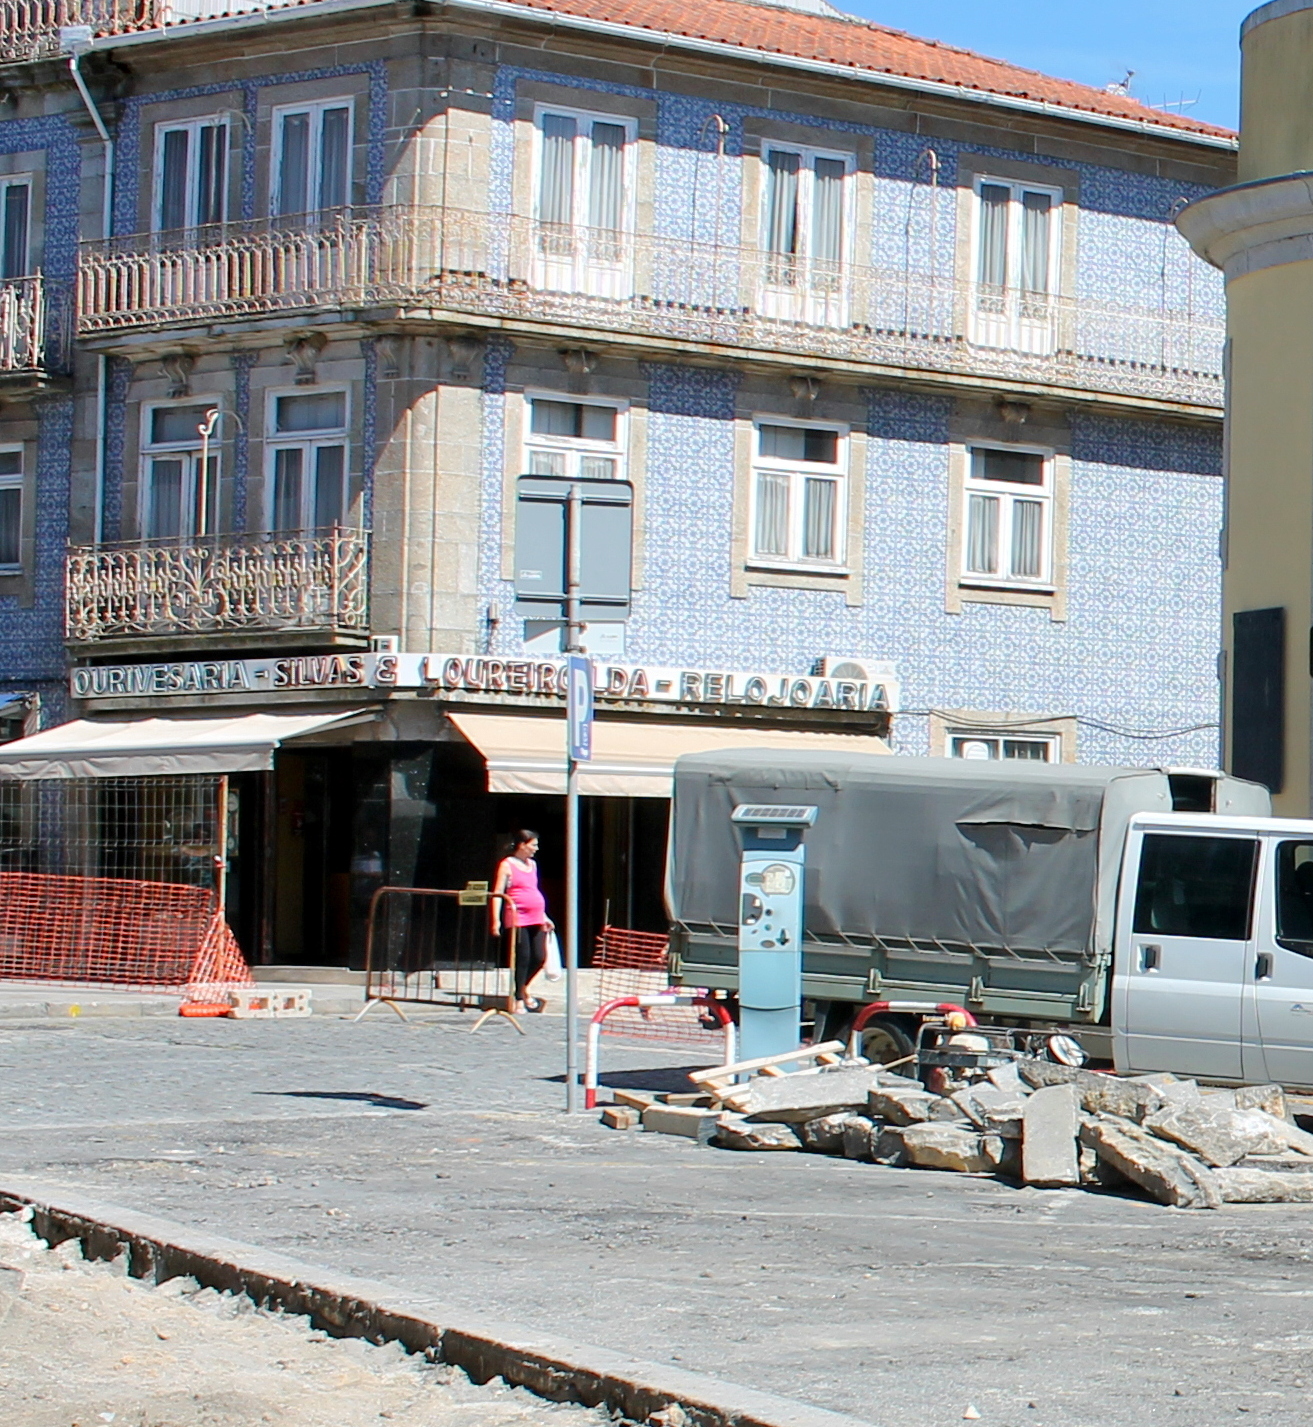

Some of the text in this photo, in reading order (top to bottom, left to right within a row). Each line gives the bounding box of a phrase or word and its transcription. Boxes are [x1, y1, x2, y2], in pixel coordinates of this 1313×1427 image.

[73, 661, 250, 695] OURIVESARIA
[273, 656, 364, 687] SILVAS
[680, 671, 891, 711] RELOJOARIA
[574, 668, 589, 747] P
